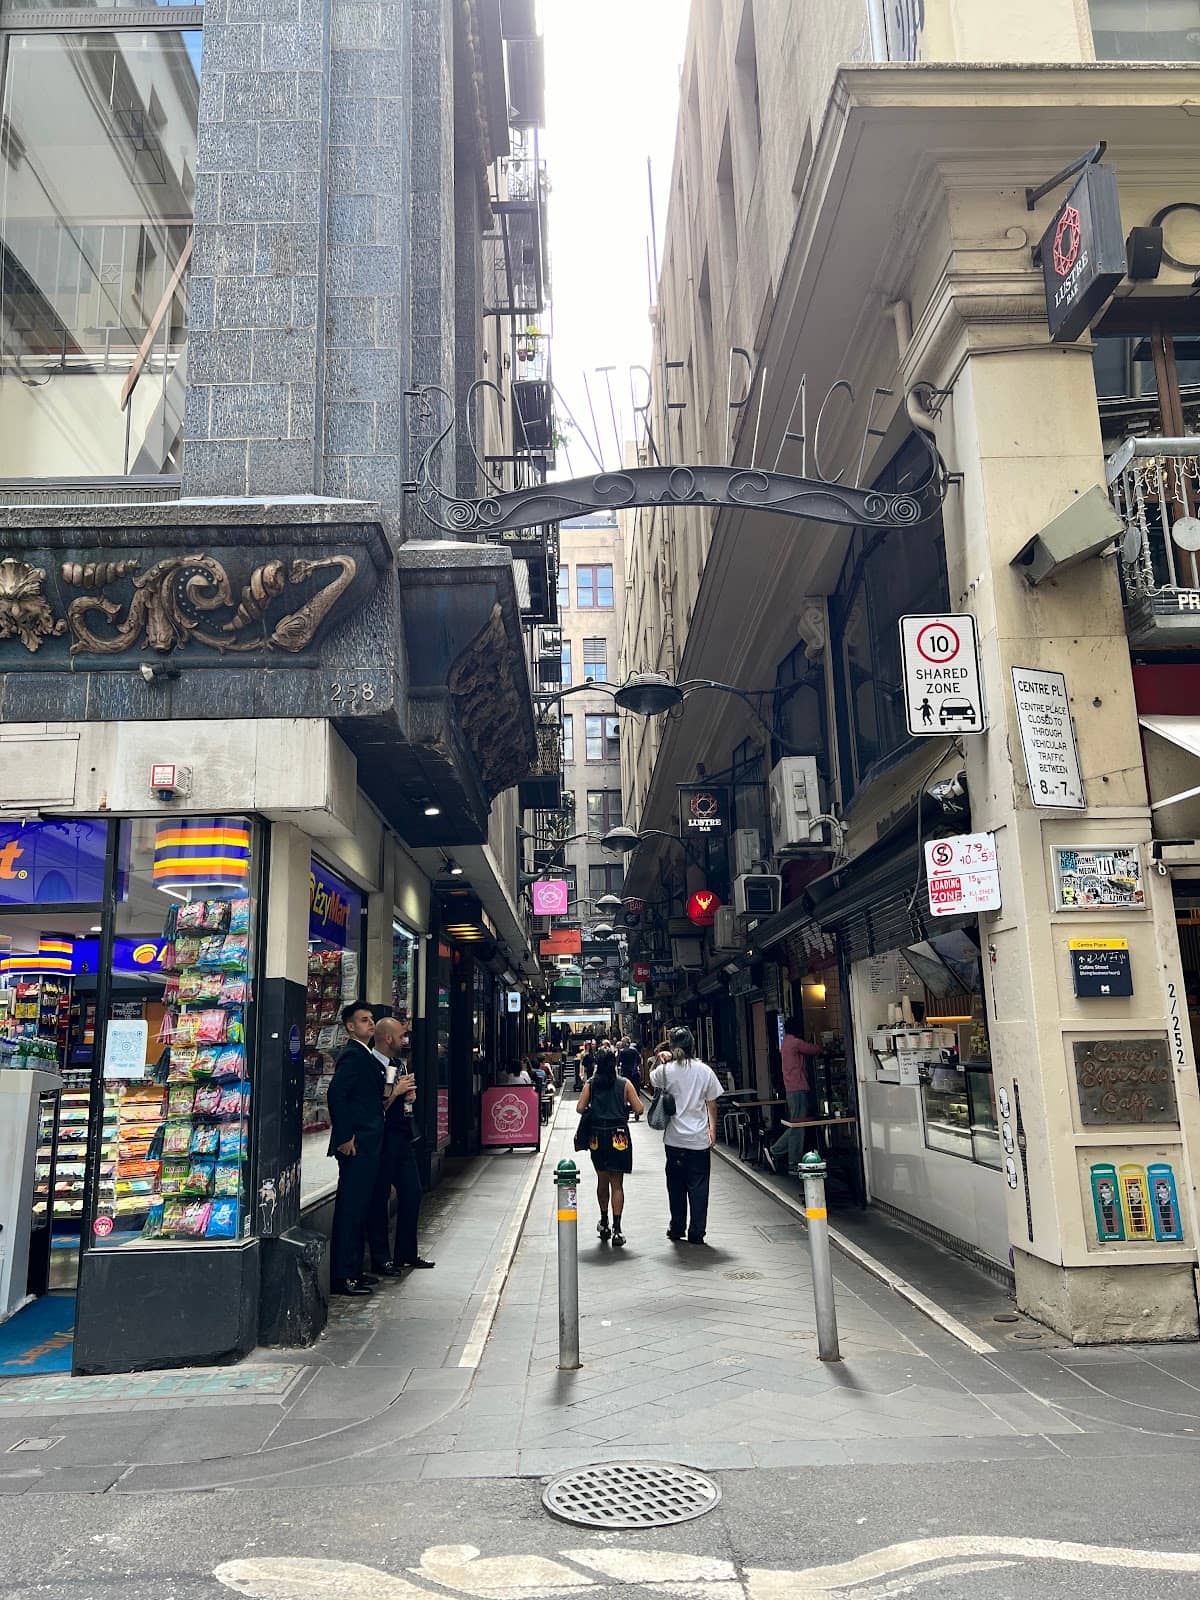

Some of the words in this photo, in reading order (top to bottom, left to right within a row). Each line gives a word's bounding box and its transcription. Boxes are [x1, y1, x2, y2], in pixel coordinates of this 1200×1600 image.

[1055, 251, 1088, 308] LUSTRE
[725, 347, 894, 488] PLACE
[930, 636, 949, 653] 10
[916, 668, 968, 679] SHARED
[331, 682, 374, 703] 258
[926, 683, 960, 694] ZONE
[1018, 681, 1050, 695] CENTRE
[1052, 685, 1062, 697] PL
[1020, 702, 1045, 713] CENTRE
[1045, 704, 1067, 715] PLACE
[1027, 714, 1052, 725] CLOSED
[1053, 718, 1062, 726] TO
[1032, 727, 1062, 738] THROUGH
[1031, 739, 1067, 751] VEHICULAR
[1038, 752, 1064, 762] TRAFFIC
[1040, 763, 1068, 774] BETWEEN
[688, 818, 721, 826] LUSTRE
[931, 879, 960, 890] LOADING
[931, 891, 961, 902] ZONE
[313, 882, 350, 929] EzyMart
